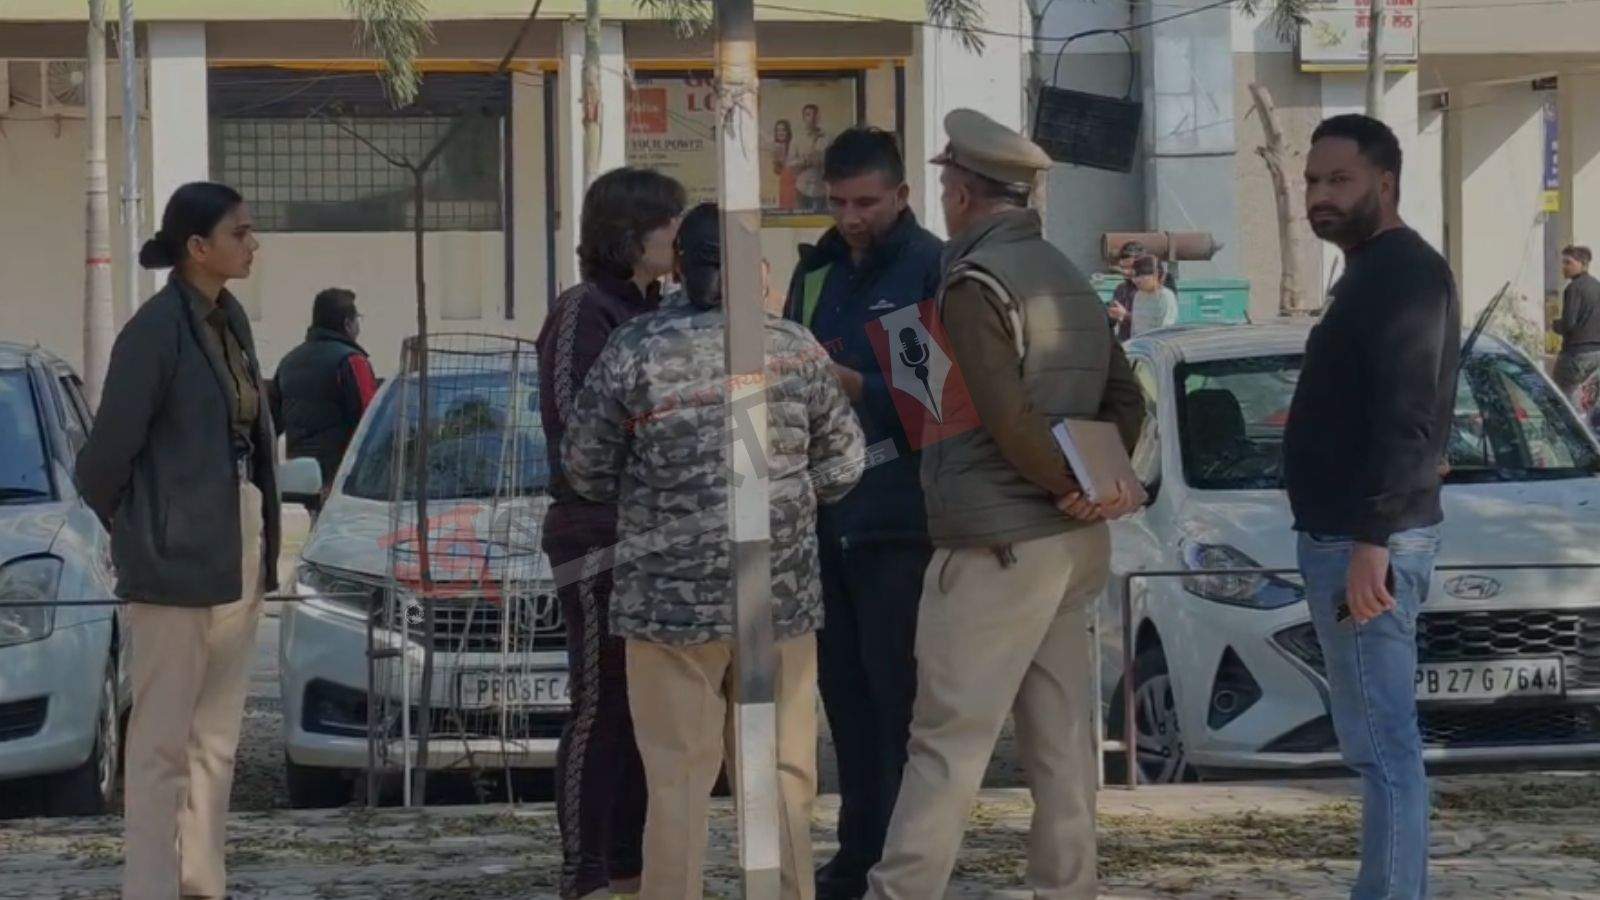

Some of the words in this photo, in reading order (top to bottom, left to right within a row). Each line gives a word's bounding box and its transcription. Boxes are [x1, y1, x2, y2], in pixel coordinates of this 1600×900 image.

[1415, 670, 1439, 693] PB
[1447, 669, 1474, 692] 27
[1482, 668, 1494, 691] G
[1503, 666, 1558, 690] 7644
